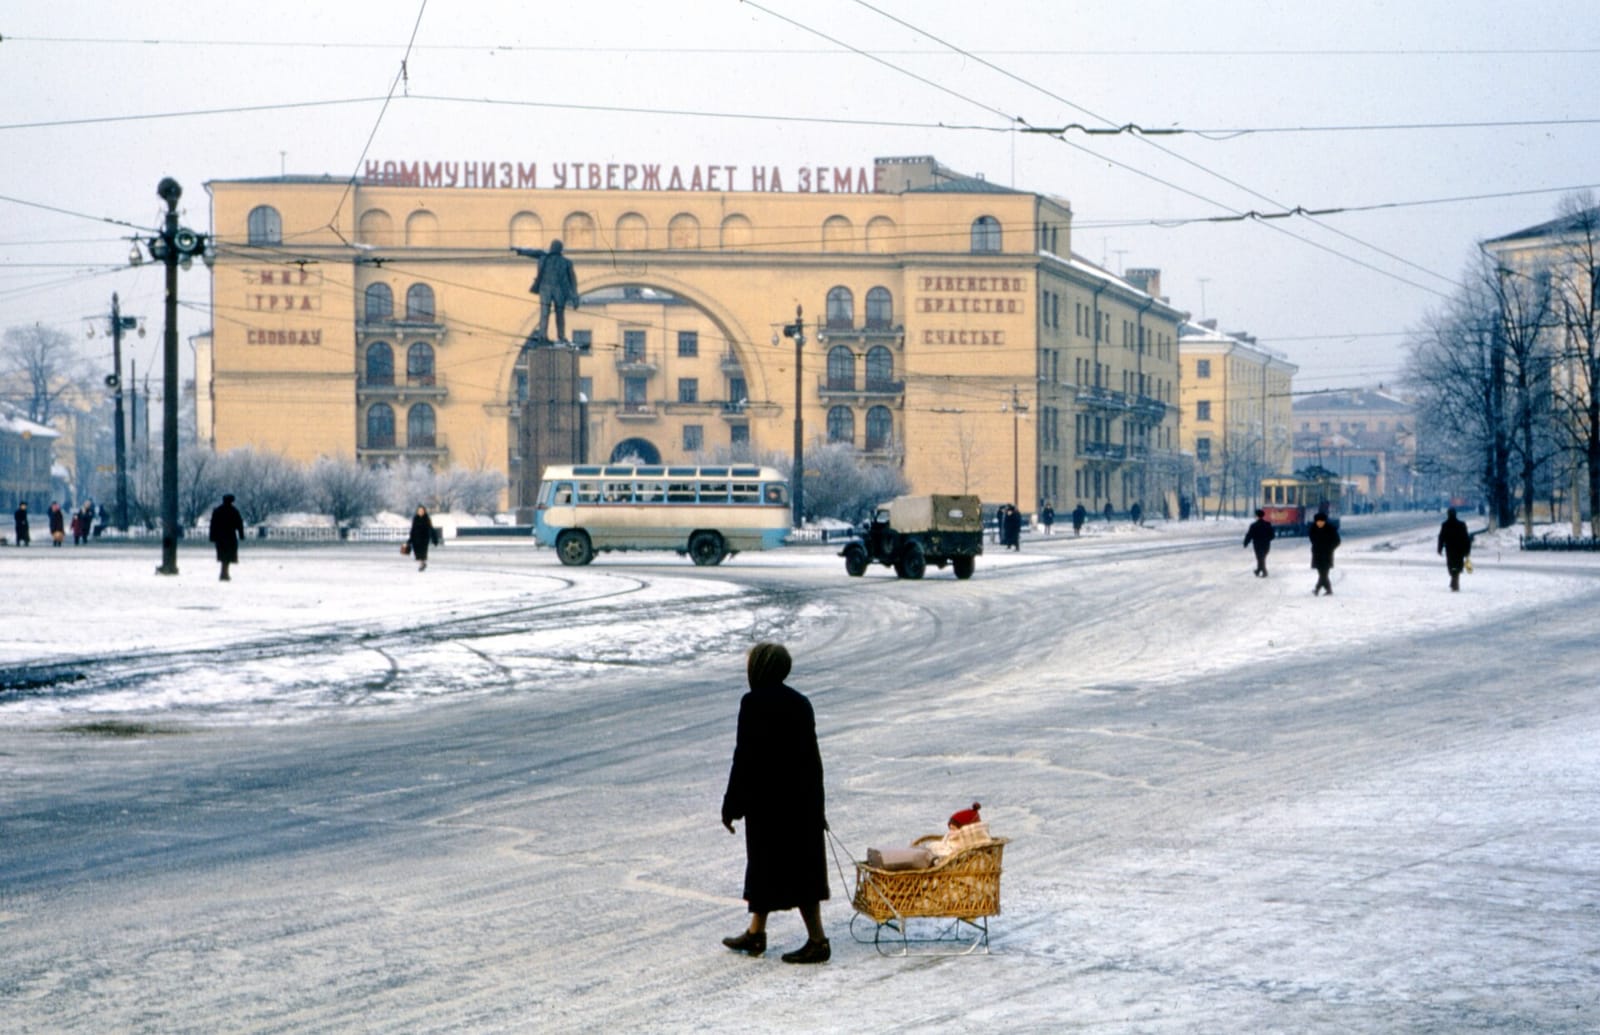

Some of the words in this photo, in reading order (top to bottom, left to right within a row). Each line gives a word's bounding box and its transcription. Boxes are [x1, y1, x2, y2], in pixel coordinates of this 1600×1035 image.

[365, 160, 537, 188] КОММУНИЗМ
[553, 163, 737, 191] УТВЕРЖДАЕТ
[752, 166, 783, 193] НА
[798, 166, 887, 194] ЗЕМЛЕ
[924, 277, 1021, 292] РАВЕНСТВО
[924, 298, 1016, 313] БРАТСТВО
[925, 330, 1001, 345] СЧАСТЬЕ
